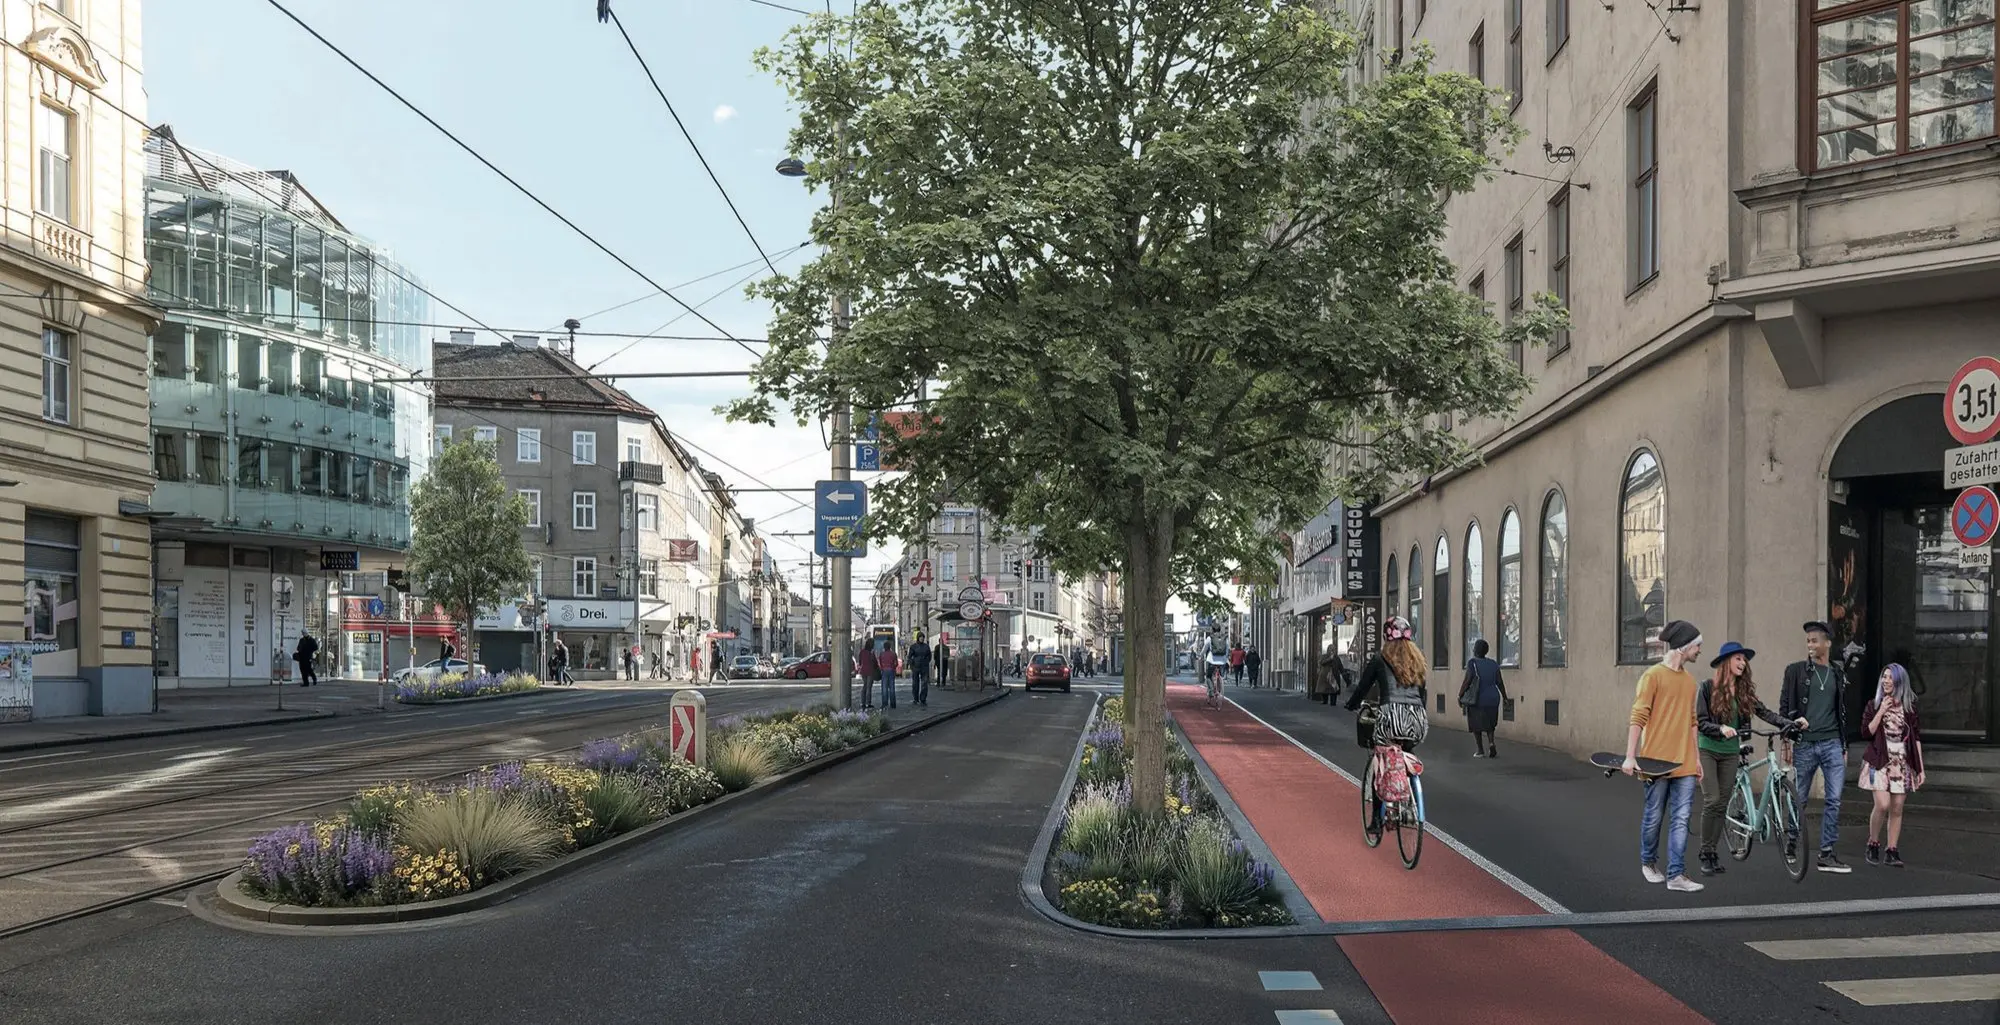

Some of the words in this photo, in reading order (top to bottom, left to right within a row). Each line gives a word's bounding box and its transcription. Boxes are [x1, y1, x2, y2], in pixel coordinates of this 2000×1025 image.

[1958, 383, 1997, 423] 3,5t
[1955, 448, 1998, 466] Zufahrt
[1950, 464, 2000, 484] gestatte
[1961, 552, 1988, 564] Anfang
[580, 608, 608, 619] Drei.
